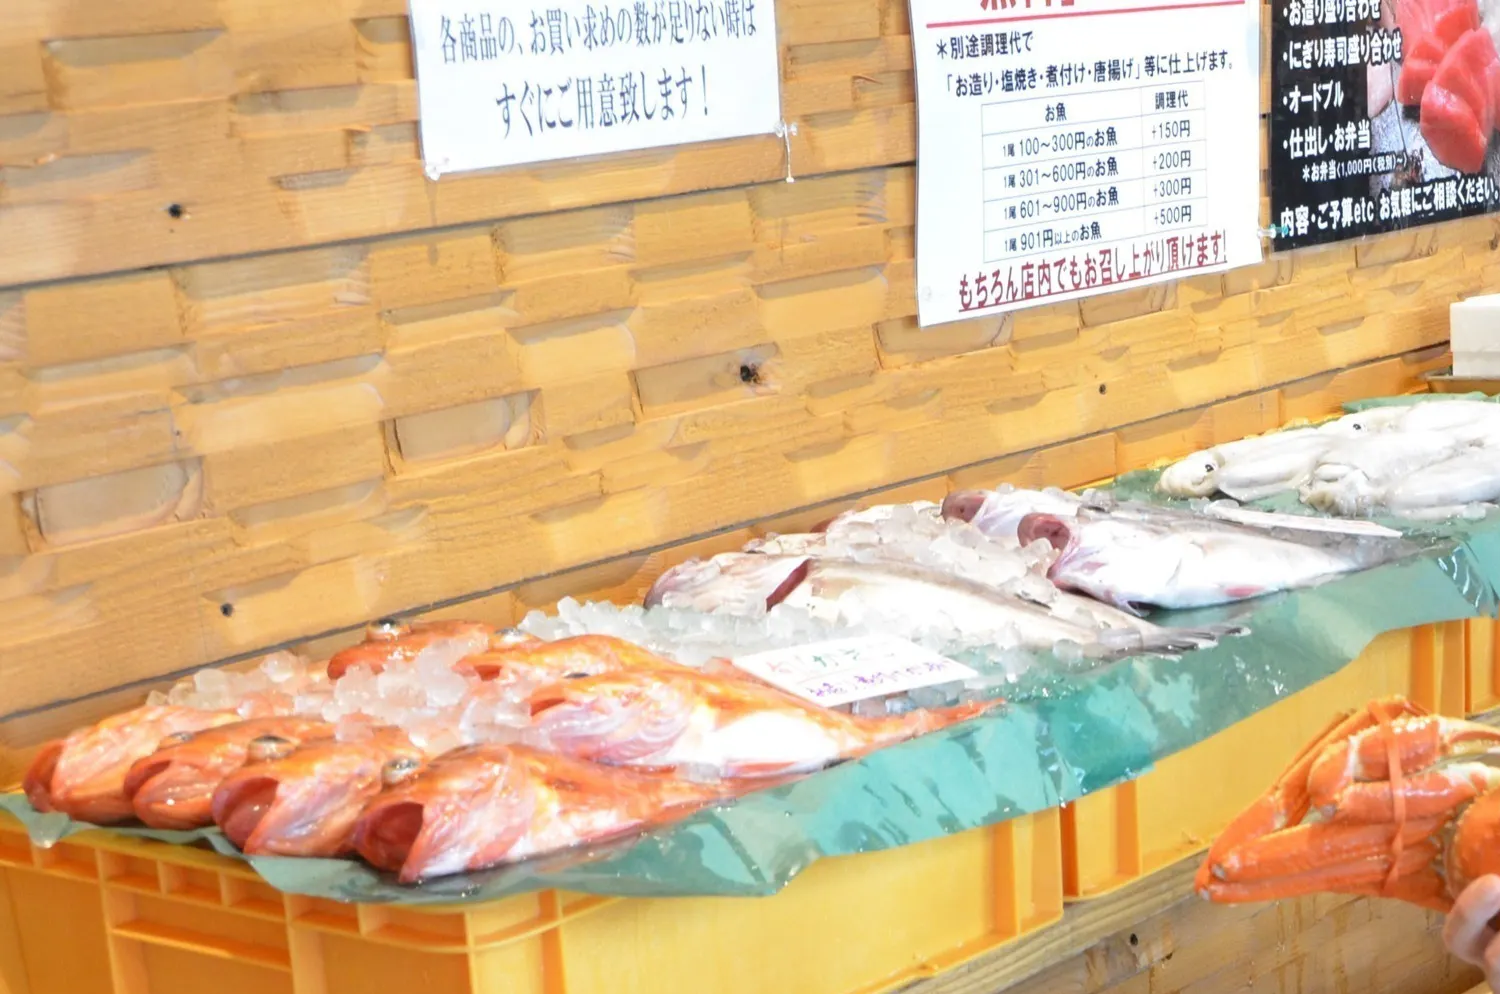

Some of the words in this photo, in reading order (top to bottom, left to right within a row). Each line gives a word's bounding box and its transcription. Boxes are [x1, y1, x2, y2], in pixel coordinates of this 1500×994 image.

[440, 0, 757, 64] 各商品の、お買い求めの数が足りない時は
[496, 65, 708, 139] すぐにご用意致します！
[1044, 102, 1067, 122] お魚
[1155, 90, 1189, 109] 調理代
